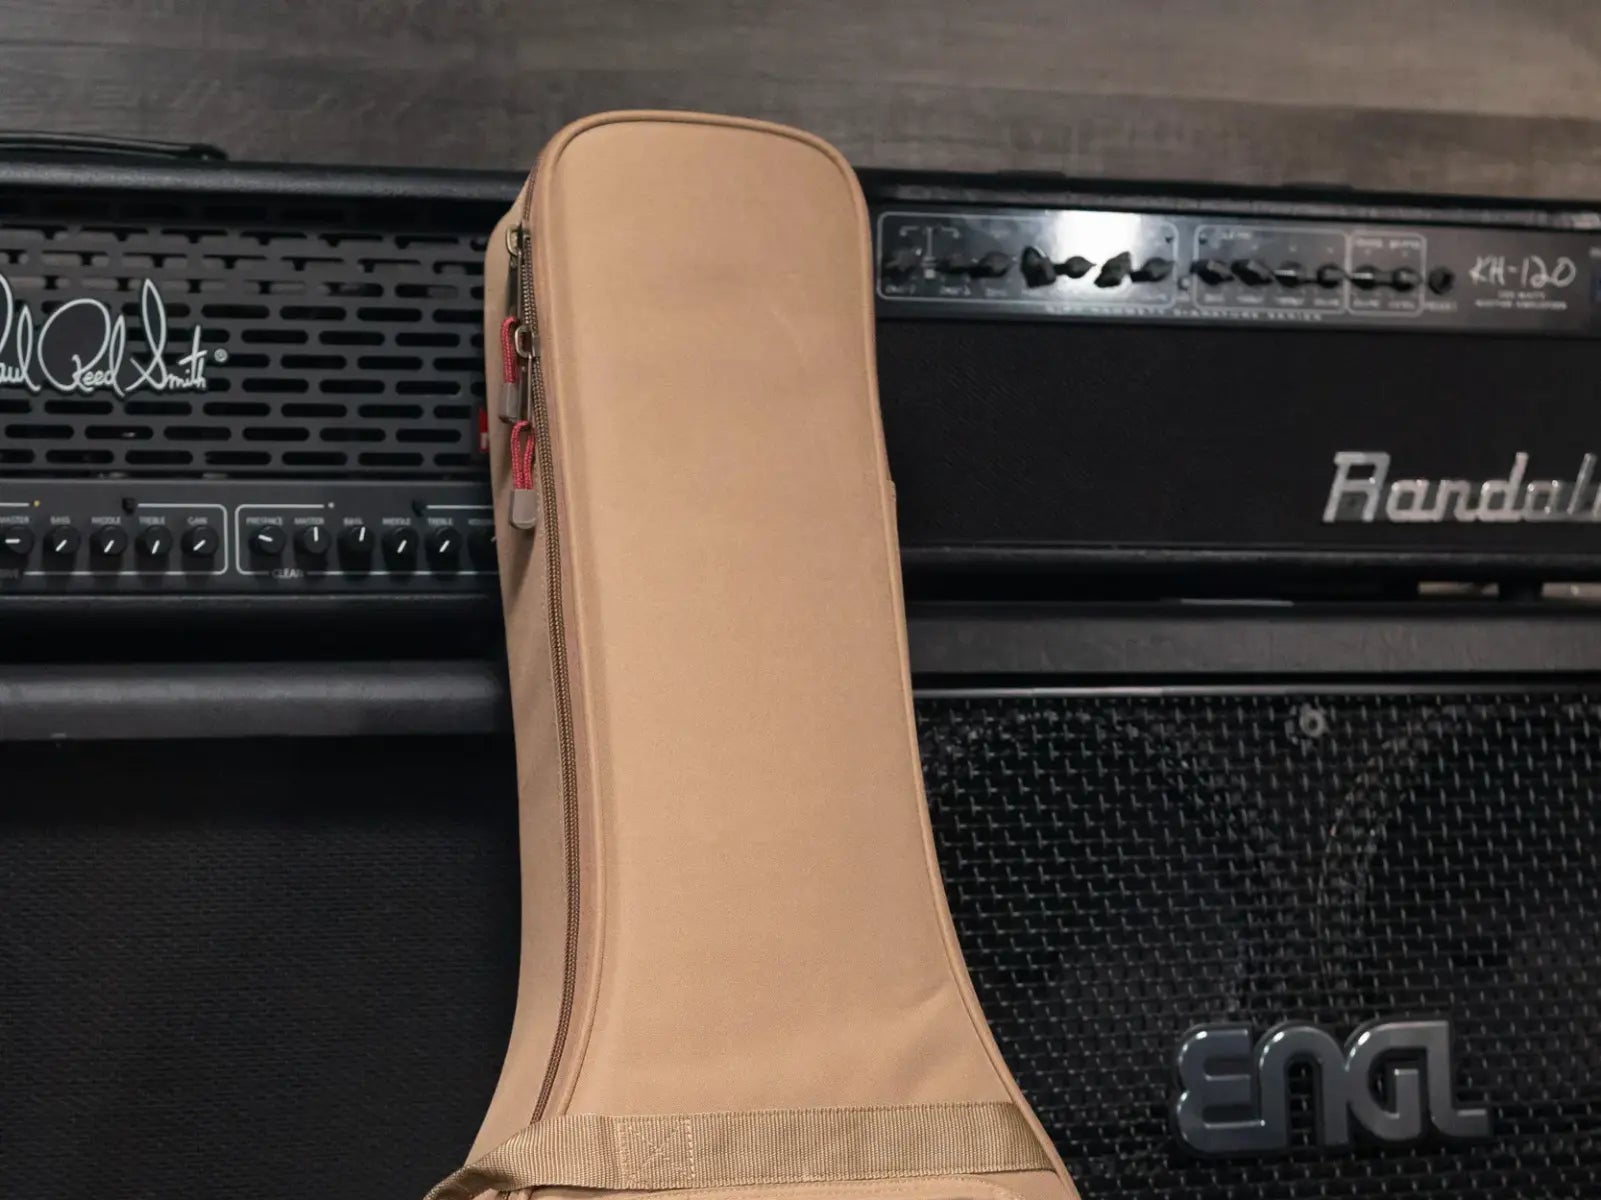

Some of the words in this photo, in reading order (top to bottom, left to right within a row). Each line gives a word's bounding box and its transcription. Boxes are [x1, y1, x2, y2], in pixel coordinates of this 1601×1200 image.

[1469, 254, 1577, 289] KH-120
[37, 298, 126, 397] Reed
[1321, 451, 1601, 523] Randal
[138, 516, 166, 526] TREBLE
[187, 516, 208, 526] GAIN
